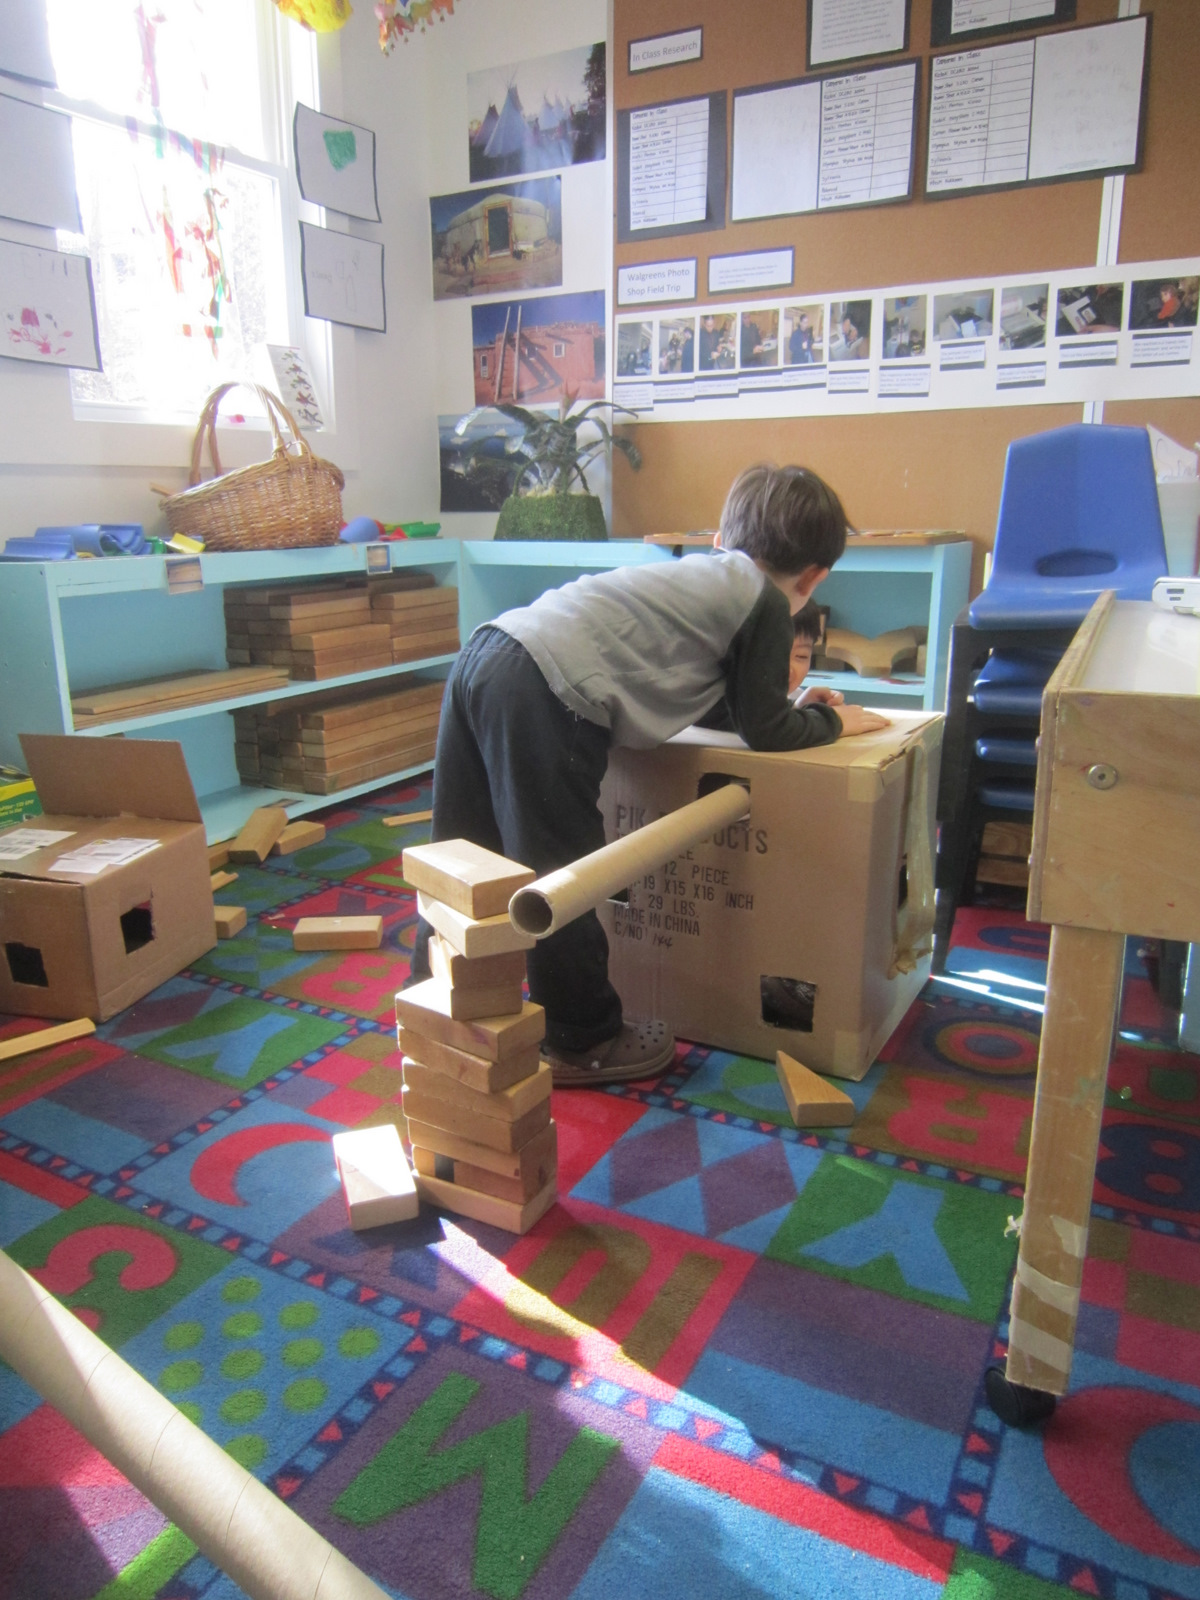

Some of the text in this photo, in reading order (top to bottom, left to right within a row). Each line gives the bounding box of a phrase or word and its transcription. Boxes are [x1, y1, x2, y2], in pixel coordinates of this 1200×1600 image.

[632, 41, 698, 62] In Class Research
[627, 268, 690, 282] Walgreens Photo
[627, 284, 681, 296] Shop Field Trip
[692, 864, 730, 886] PIECE
[664, 878, 686, 897] X15
[693, 884, 715, 902] X16
[725, 892, 755, 911] INCH
[648, 895, 701, 919] 29 LBS.
[613, 903, 701, 937] MADE IN CHINA
